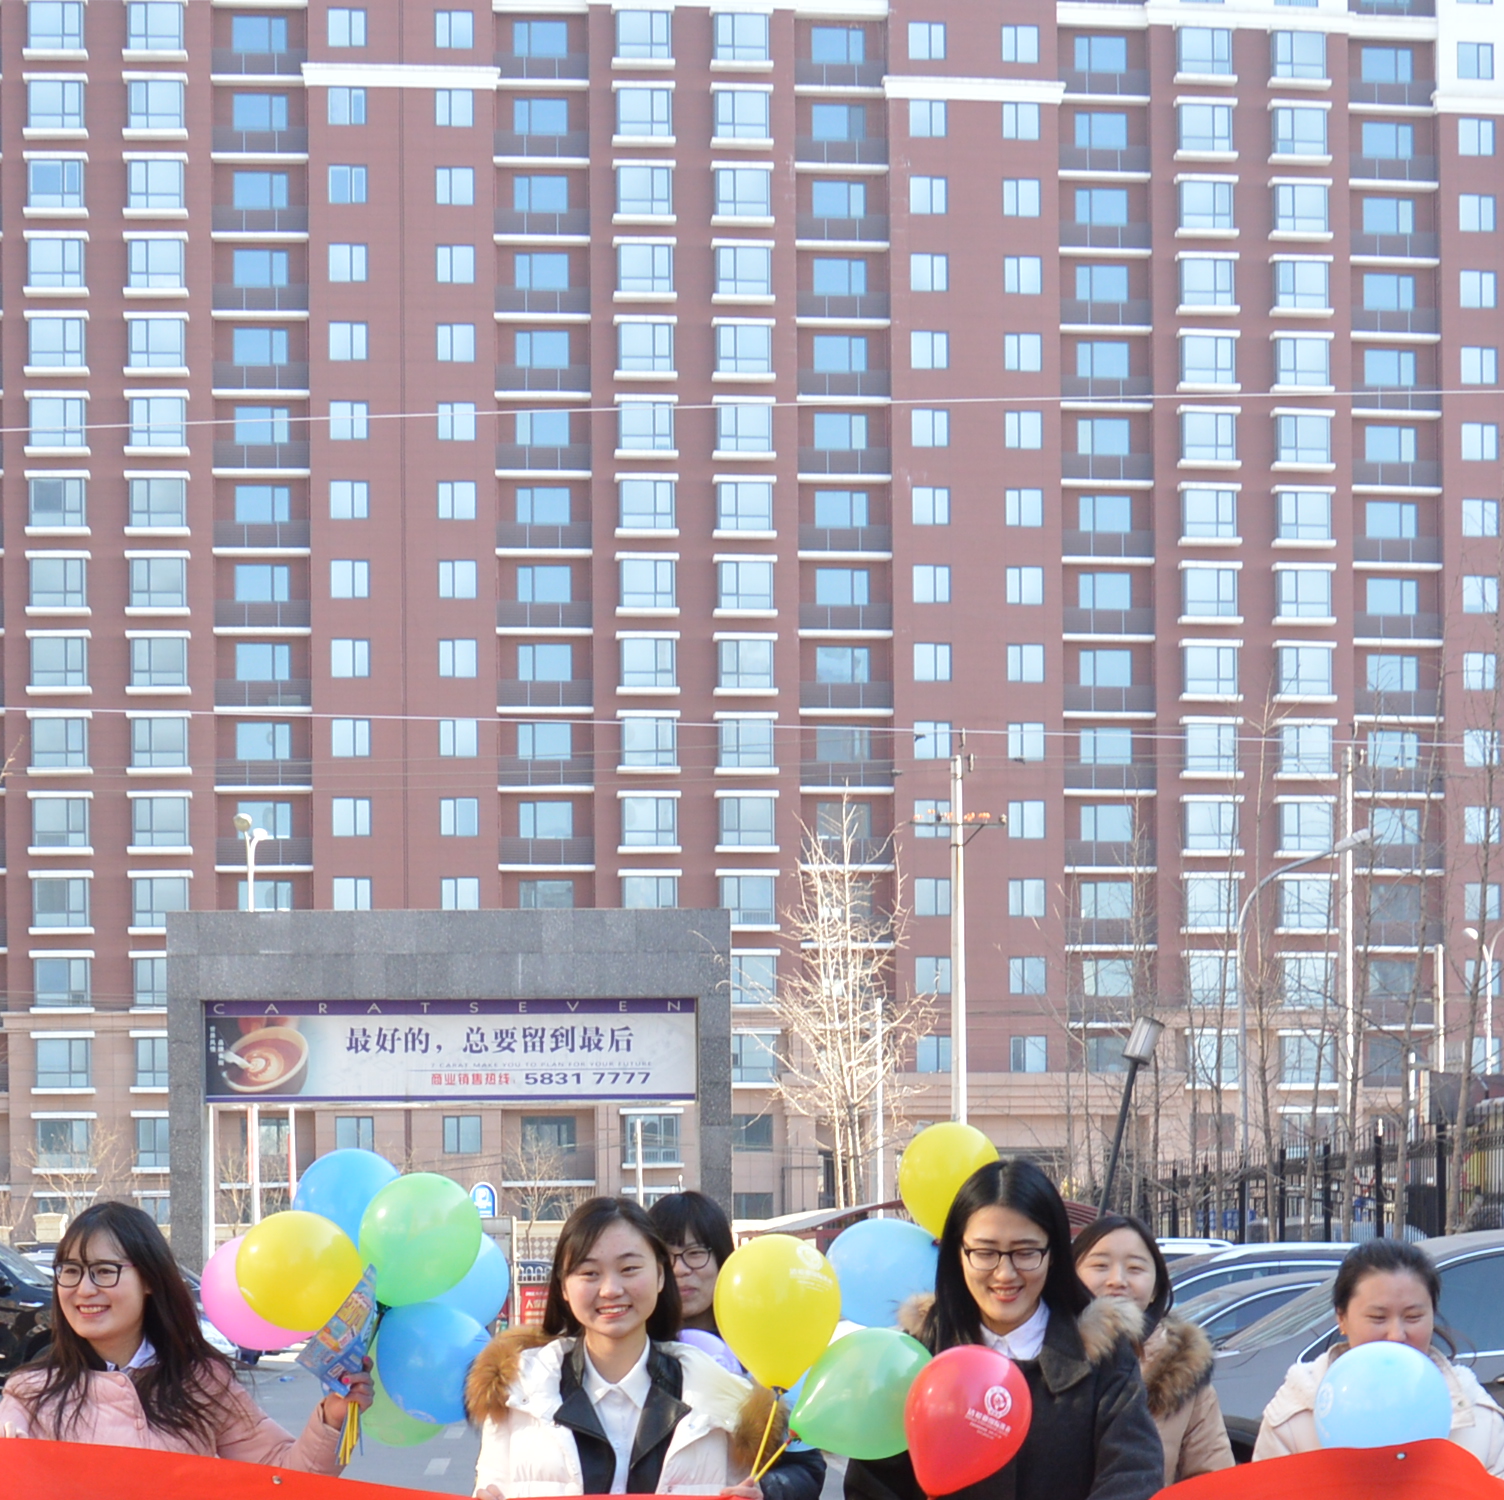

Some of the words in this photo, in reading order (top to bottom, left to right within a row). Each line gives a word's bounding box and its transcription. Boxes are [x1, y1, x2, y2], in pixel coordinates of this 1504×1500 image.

[346, 1025, 634, 1055] 最好的，总要留到最后
[525, 1072, 582, 1085] 5831
[592, 1072, 652, 1085] 7777
